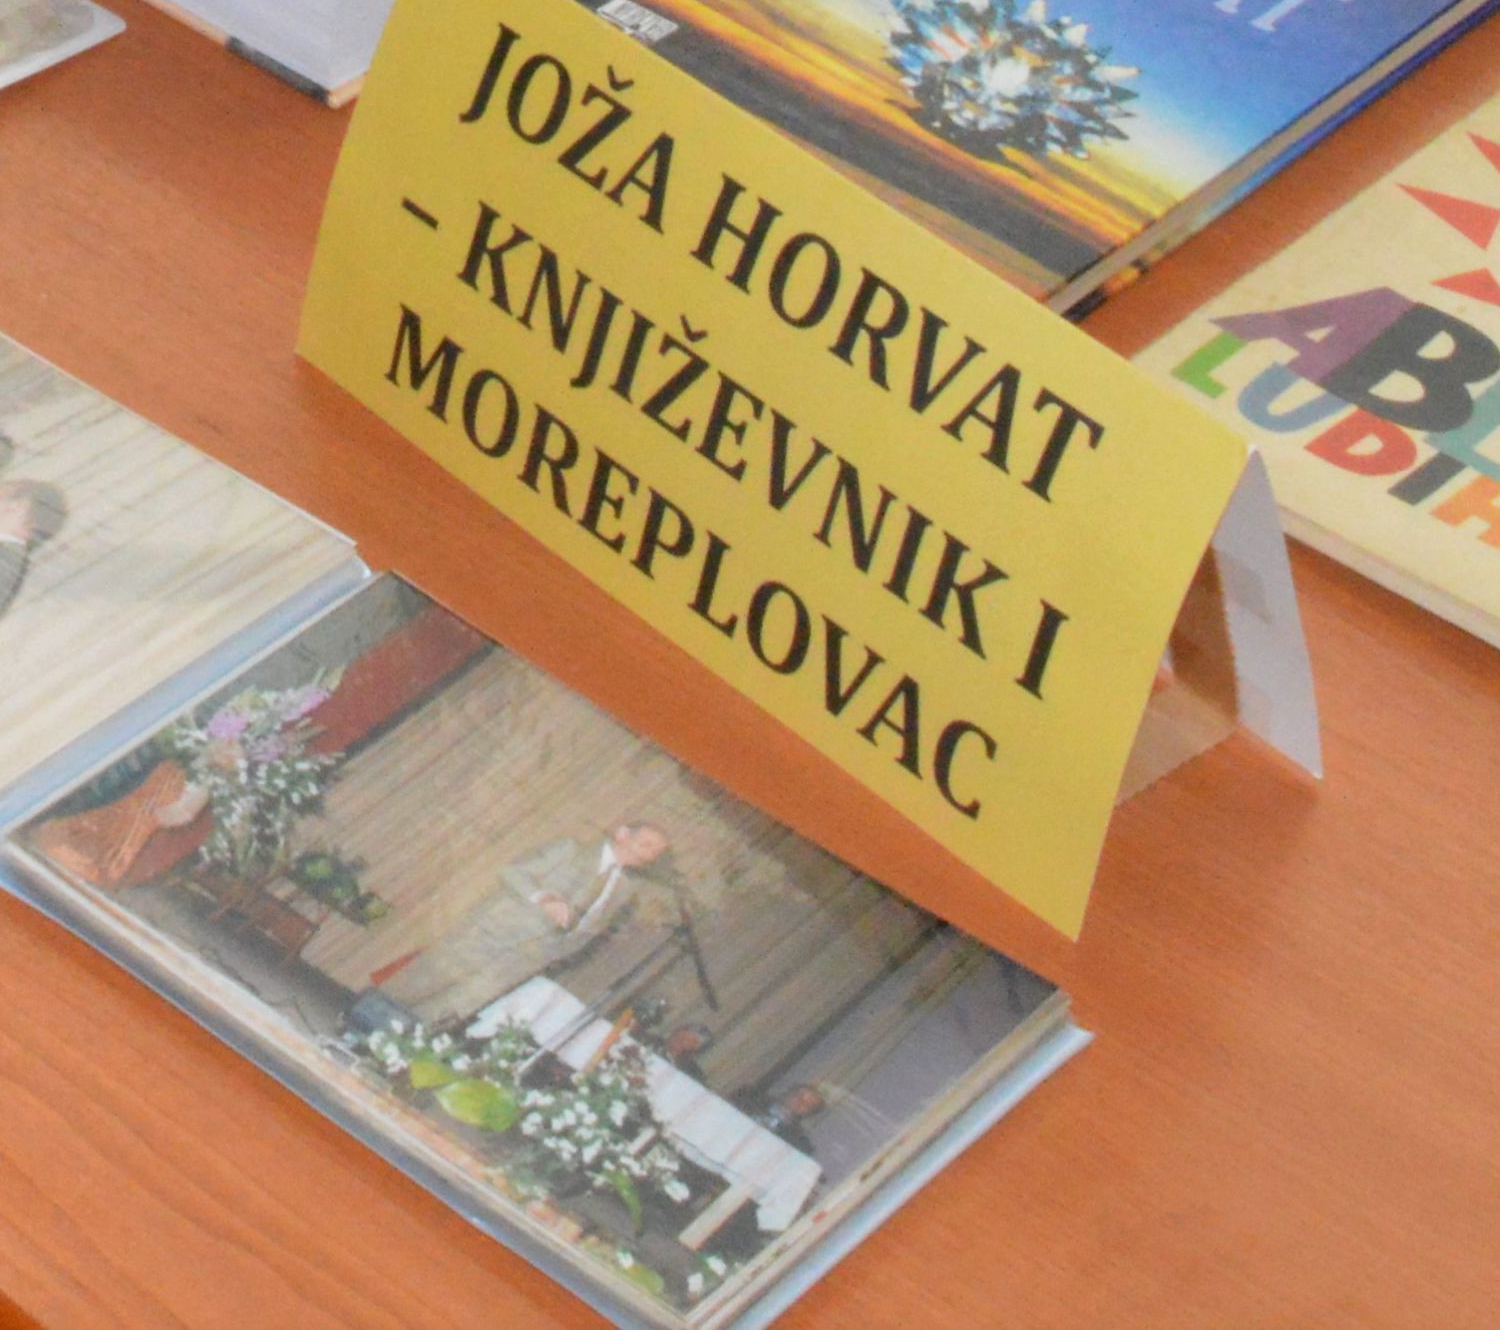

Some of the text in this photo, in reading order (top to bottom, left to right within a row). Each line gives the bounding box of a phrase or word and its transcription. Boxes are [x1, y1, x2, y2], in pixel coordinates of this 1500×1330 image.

[457, 200, 1012, 660] KNJIŽEVNIK
[1014, 598, 1072, 700] I
[458, 22, 1105, 506] JOŽA HORVAT
[383, 304, 1000, 821] MOREPLOVAC
